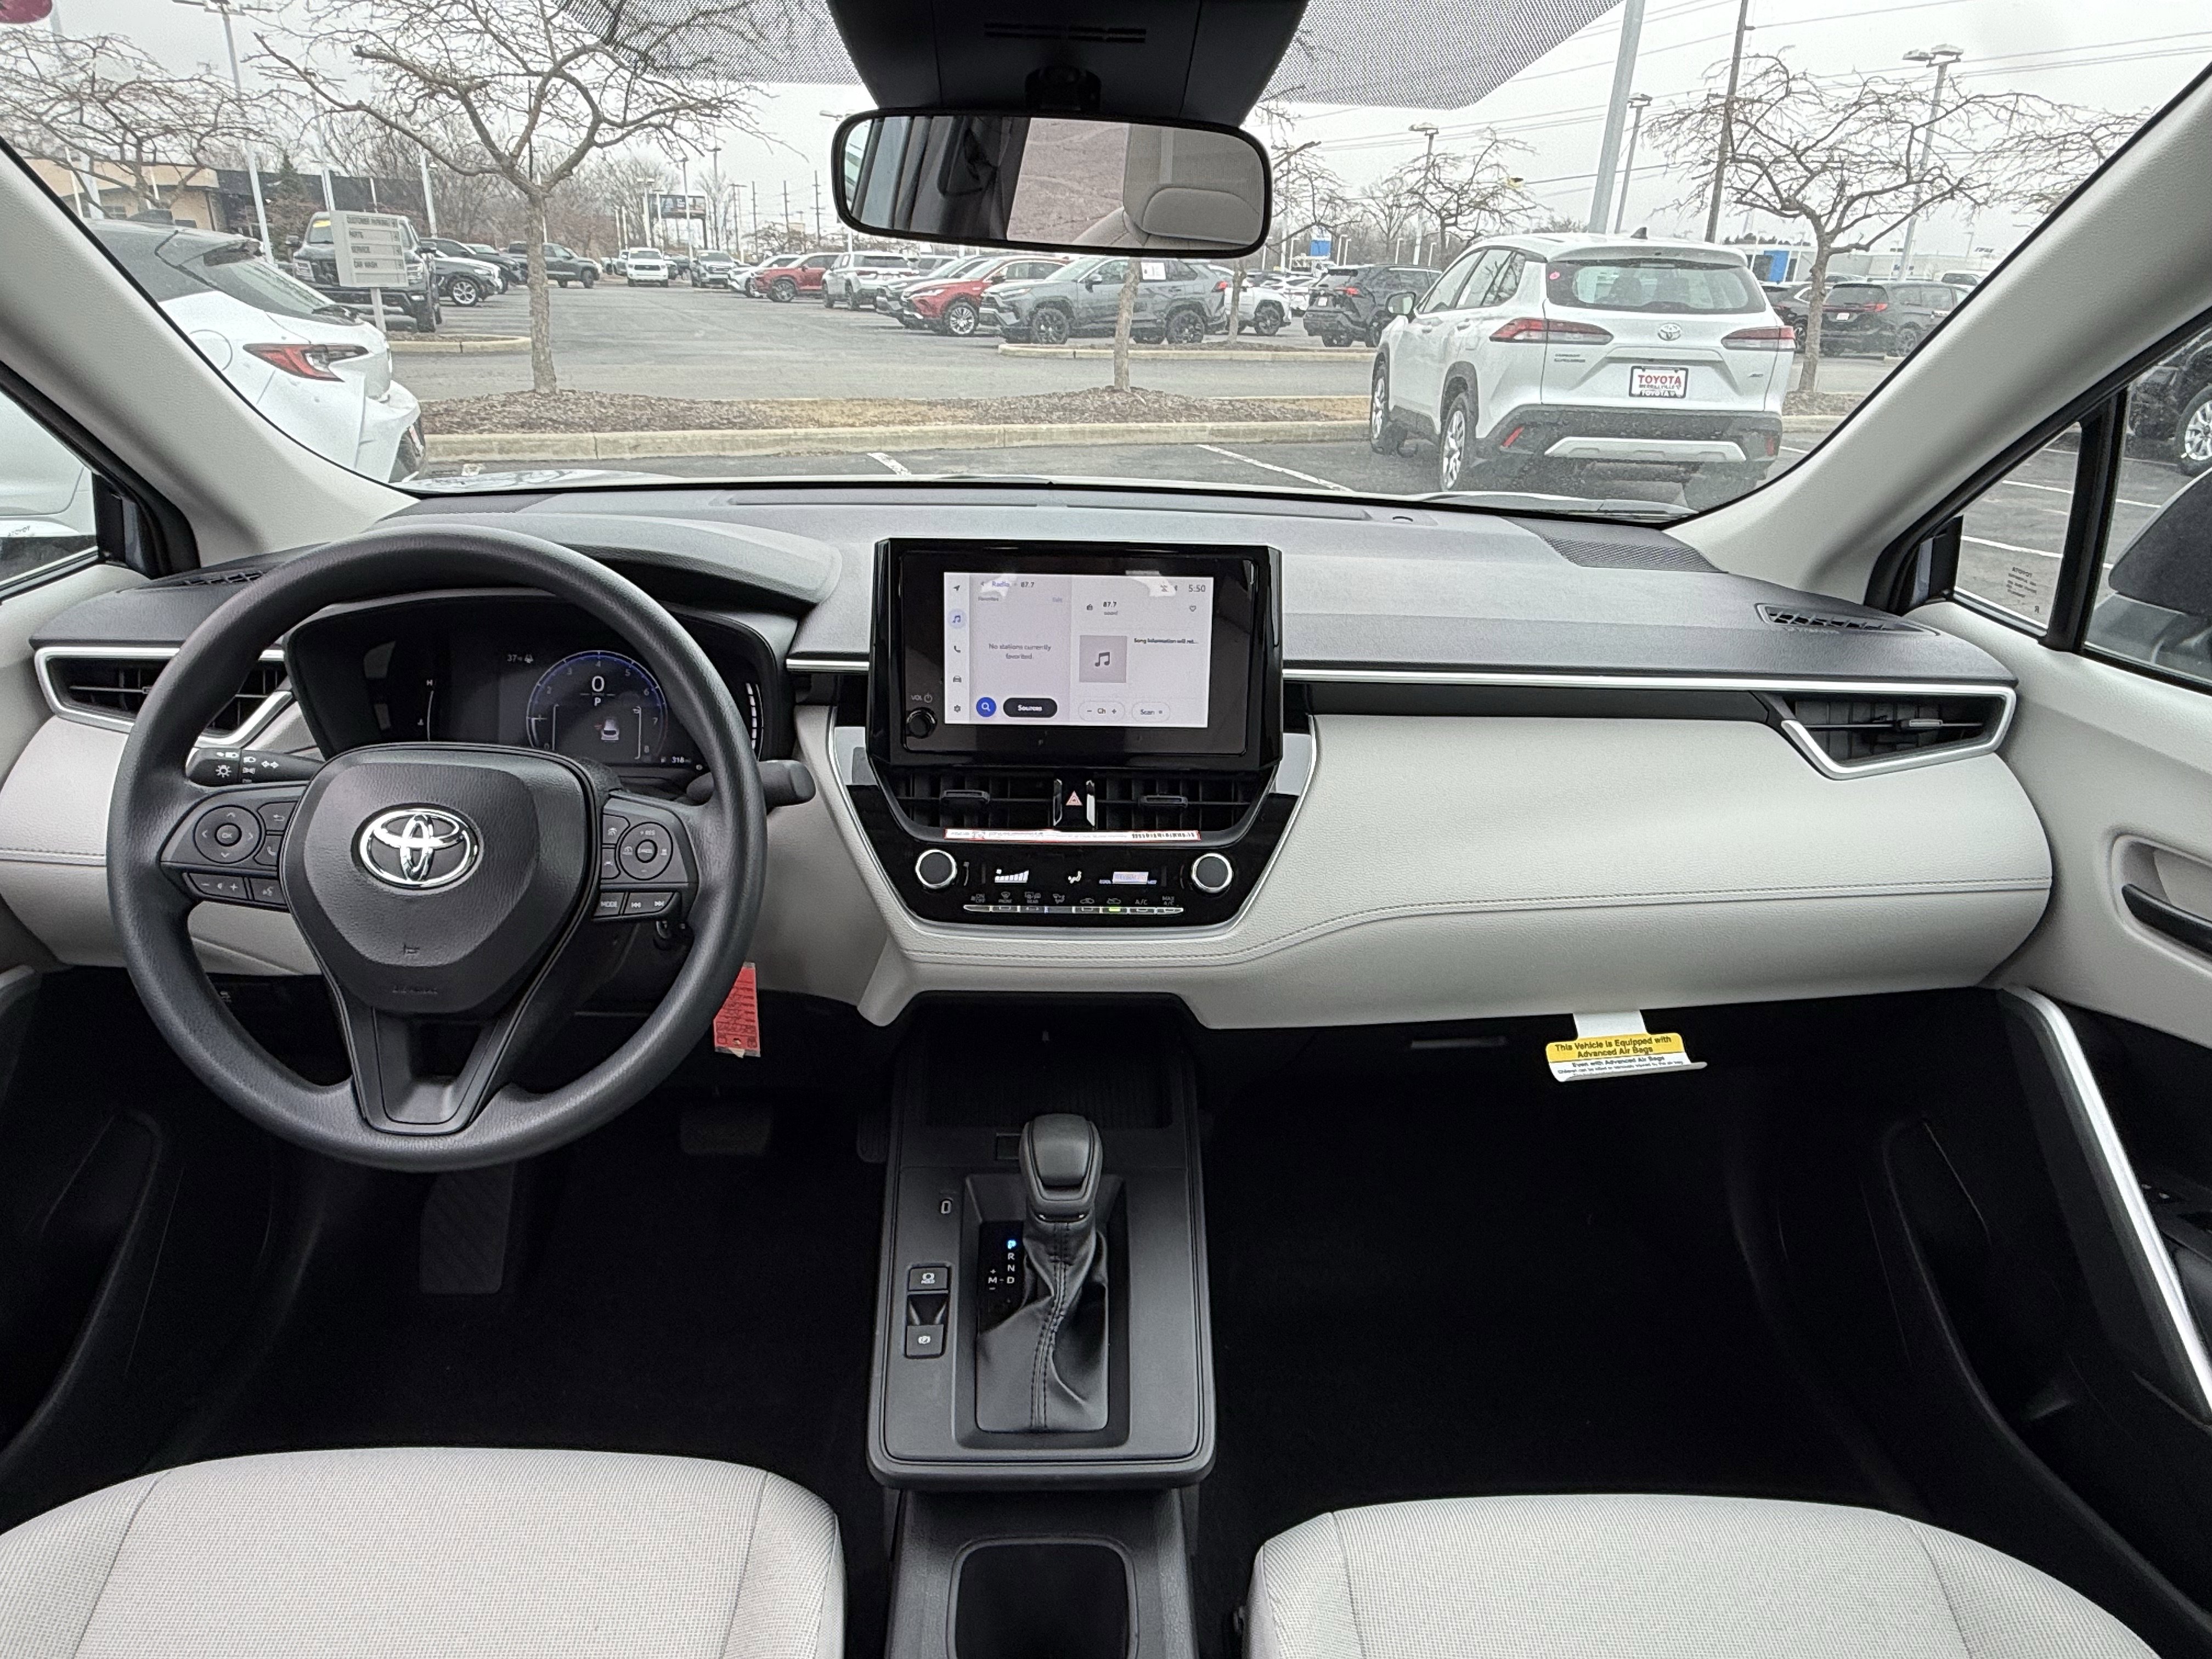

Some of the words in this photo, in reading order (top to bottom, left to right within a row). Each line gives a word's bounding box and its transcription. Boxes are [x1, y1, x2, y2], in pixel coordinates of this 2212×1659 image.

[1638, 375, 1681, 385] TOYOTA
[591, 675, 605, 692] 0
[594, 697, 601, 706] P
[1574, 1041, 1604, 1049] Vehicle
[1615, 1036, 1653, 1049] Equipped
[1578, 1048, 1617, 1058] Advanced
[1632, 1046, 1654, 1054] Bags
[1007, 1239, 1017, 1249] P
